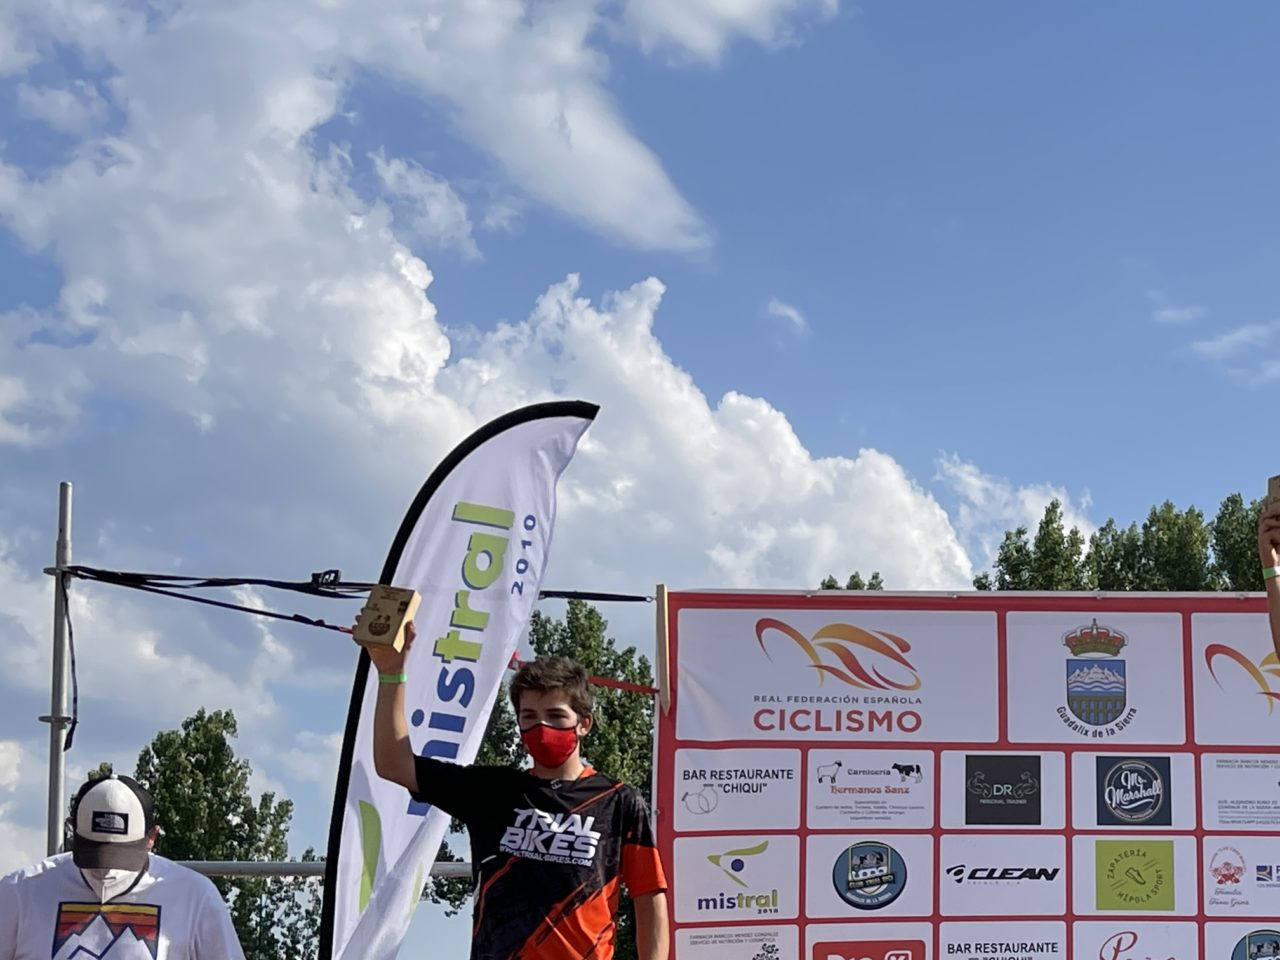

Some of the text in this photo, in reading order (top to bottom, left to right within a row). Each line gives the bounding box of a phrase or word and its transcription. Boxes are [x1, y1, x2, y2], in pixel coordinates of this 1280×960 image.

[511, 513, 537, 597] 2010
[753, 694, 922, 704] REAL FEDERACIÓN ESPAÑOLA
[753, 708, 922, 733] CICLISMO
[1056, 705, 1137, 738] Guadalix de la Sierra
[683, 768, 794, 781] BAR RESTAURANTE
[717, 783, 768, 795] "CHIQUI"
[993, 784, 1013, 796] DR
[1104, 779, 1163, 808] Marshall
[513, 808, 601, 840] TRIAL
[500, 826, 598, 859] BIKES
[967, 867, 1061, 881] CLEAN
[1107, 848, 1147, 879] ZAPATERÍA
[1150, 869, 1163, 895] SPORT
[697, 889, 779, 911] mistral
[947, 942, 1059, 955] BAR RESTAURANTE
